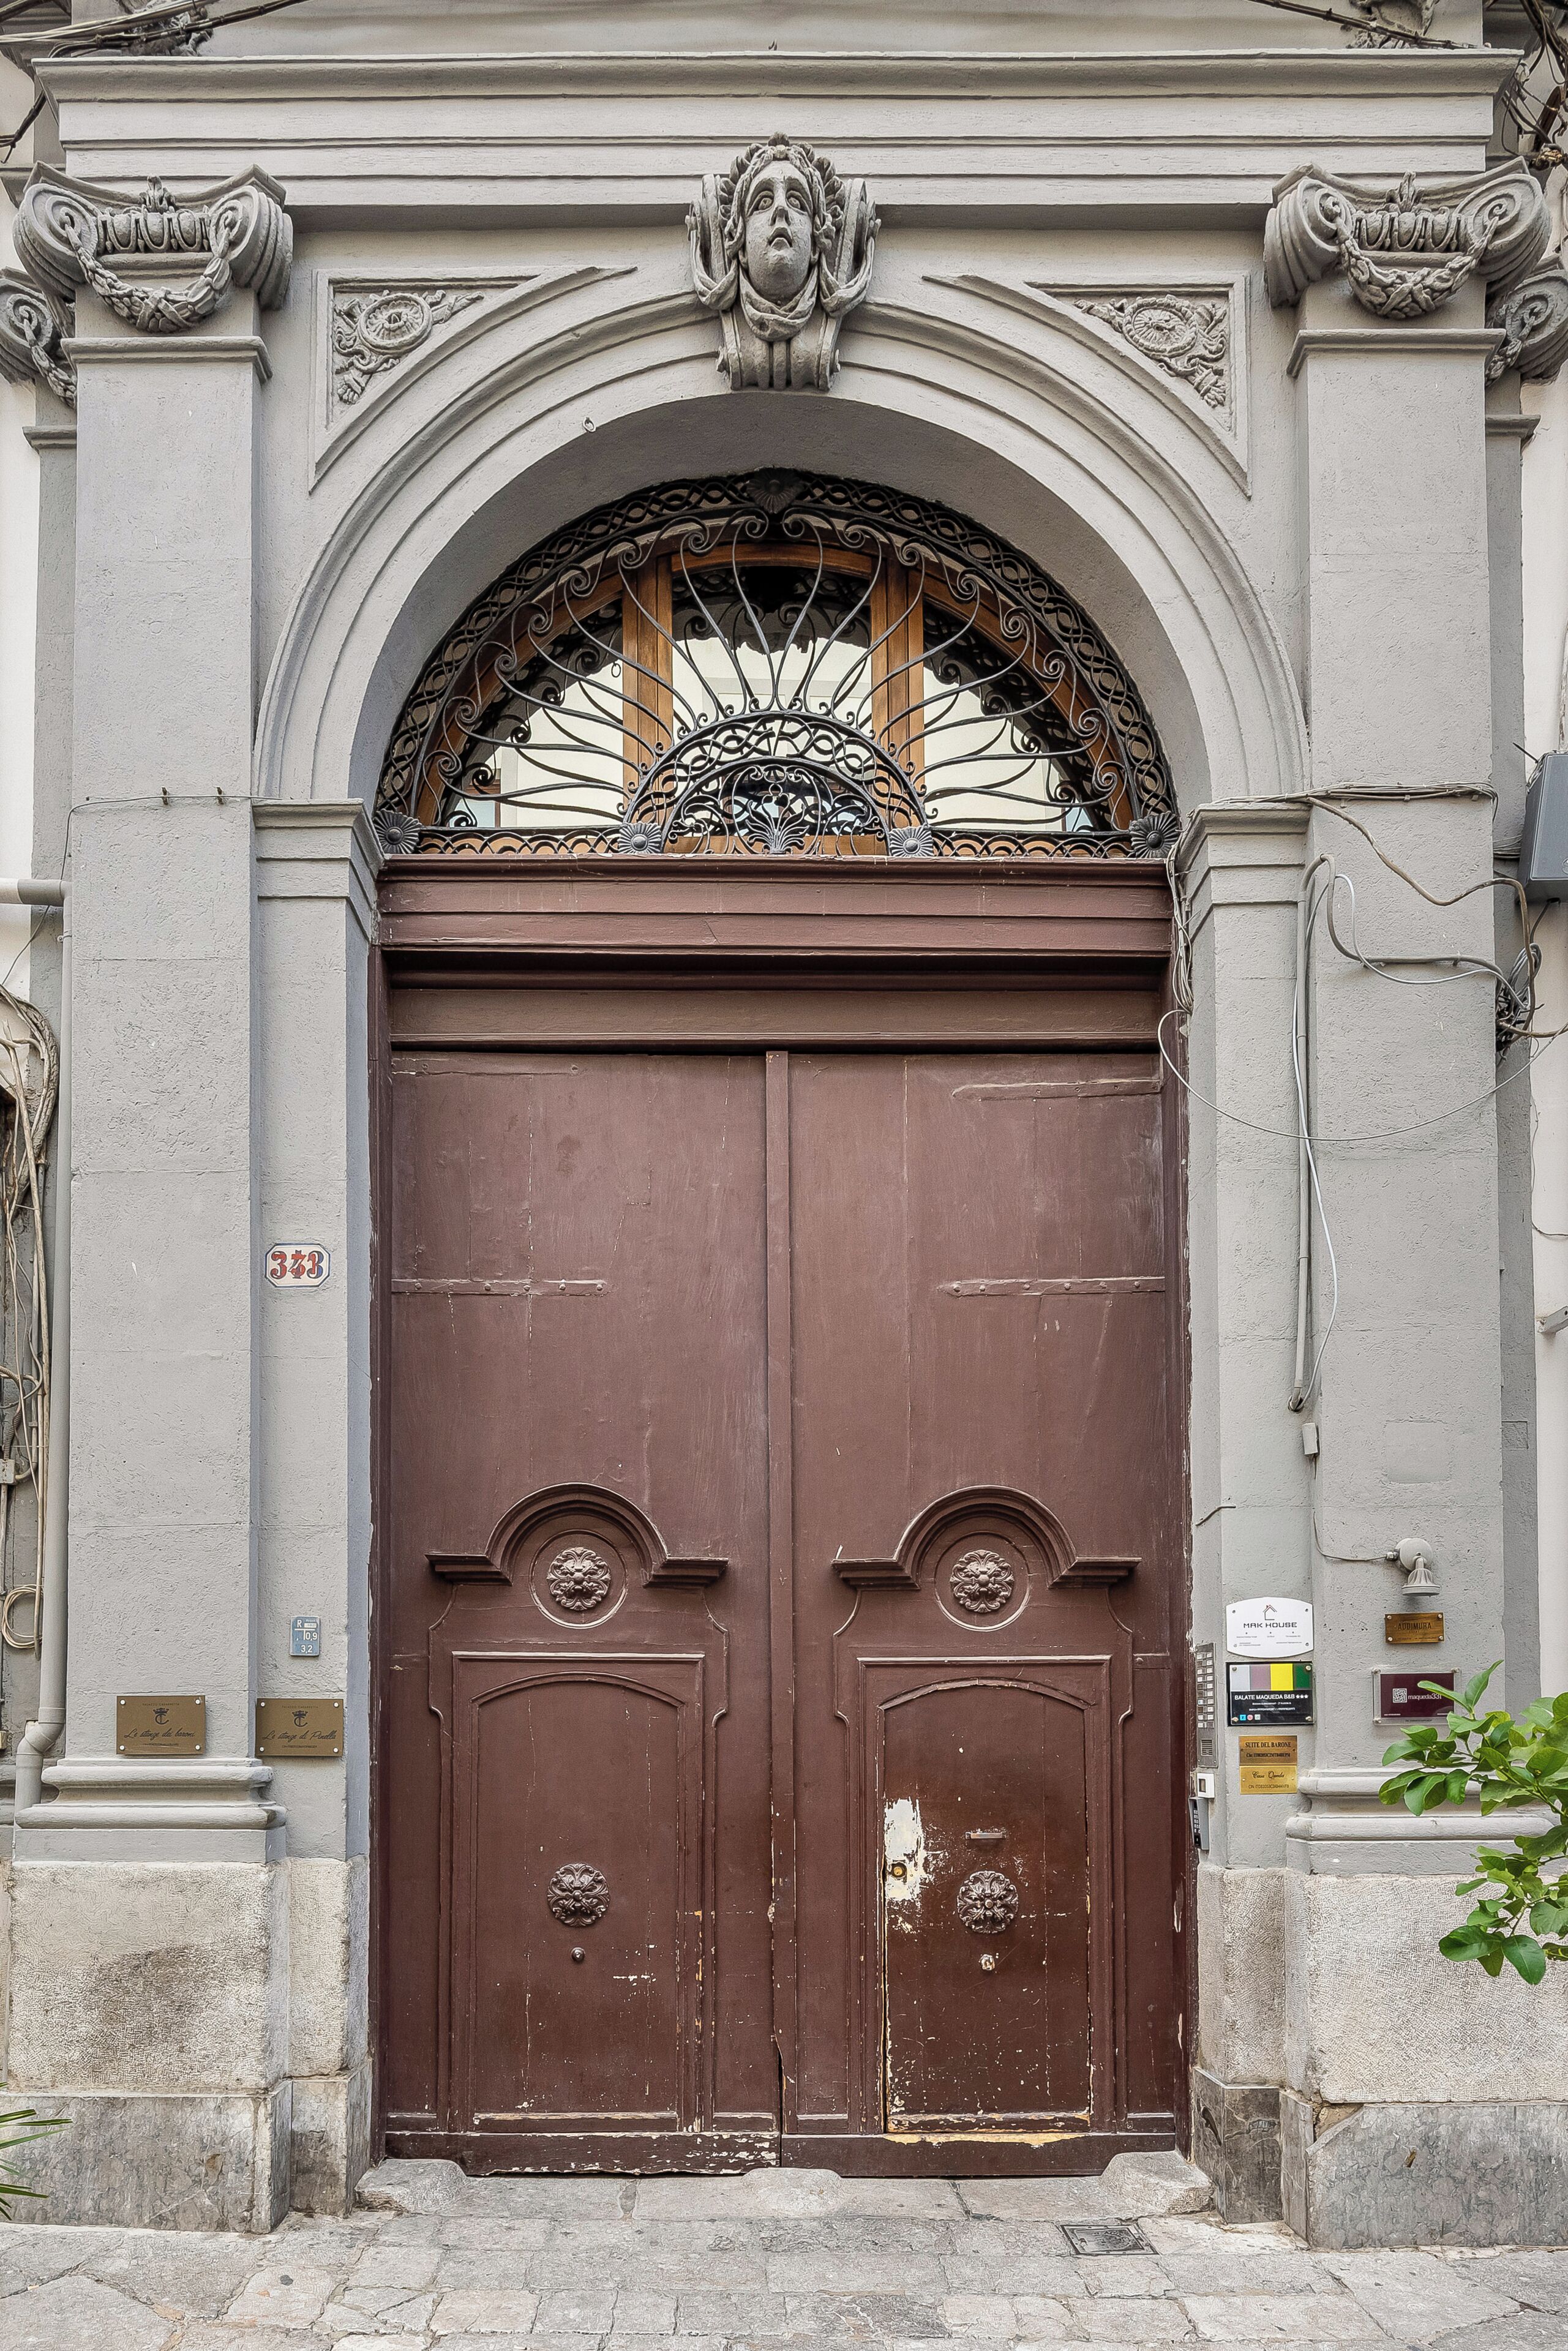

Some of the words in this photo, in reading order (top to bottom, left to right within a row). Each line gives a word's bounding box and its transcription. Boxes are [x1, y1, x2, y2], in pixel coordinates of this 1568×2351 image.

[297, 1619, 302, 1628] R
[124, 1728, 138, 1738] Le
[140, 1729, 160, 1741] stanze
[262, 1730, 275, 1741] Le
[277, 1731, 297, 1742] stanze
[299, 1730, 309, 1739] di
